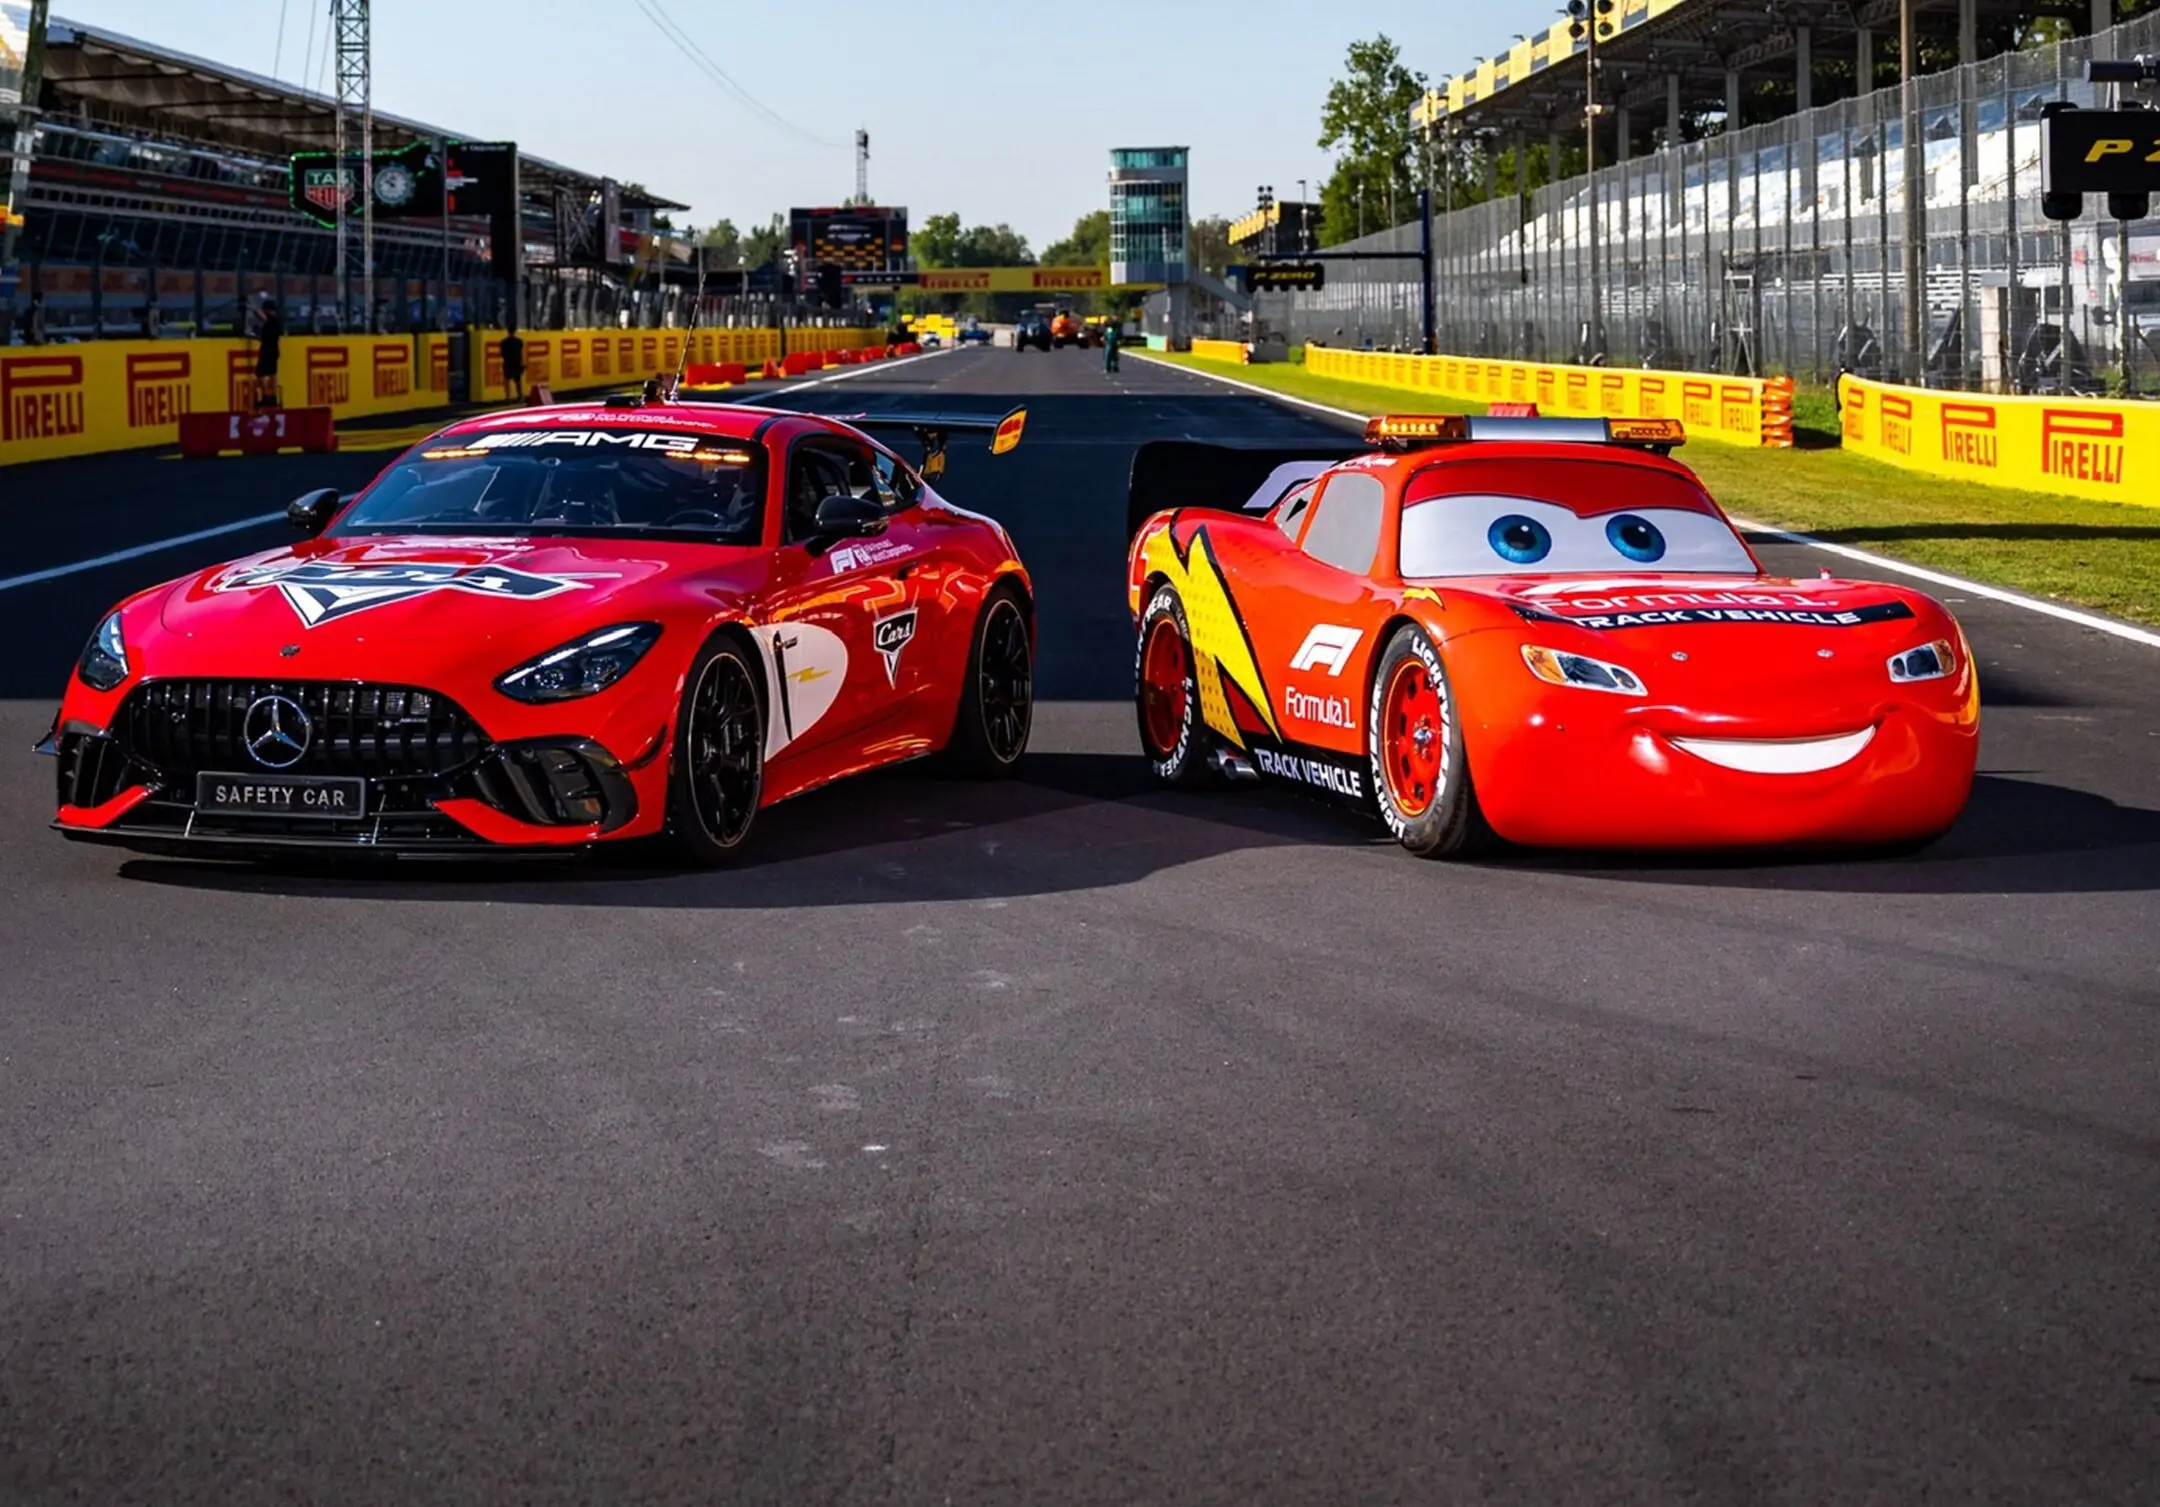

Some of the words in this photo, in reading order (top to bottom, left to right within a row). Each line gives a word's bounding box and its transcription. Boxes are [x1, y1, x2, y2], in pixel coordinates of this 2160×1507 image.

[2084, 139, 2134, 163] P
[1, 356, 84, 441] PIRELLI
[126, 352, 191, 428] PIRELLI
[531, 431, 699, 452] AMG
[1879, 394, 1913, 456] PIRELLI
[1940, 402, 1998, 468] PIRELLI
[2041, 409, 2124, 484] PIRELLI
[877, 621, 911, 647] Cars
[1574, 610, 1692, 628] TRACK
[1696, 609, 1862, 625] VEHICLE
[1288, 623, 1364, 677] F1
[215, 784, 294, 804] SAFETY
[302, 788, 345, 807] CAR
[1253, 747, 1302, 780] TRACK
[1299, 757, 1364, 798] VEHICLE
